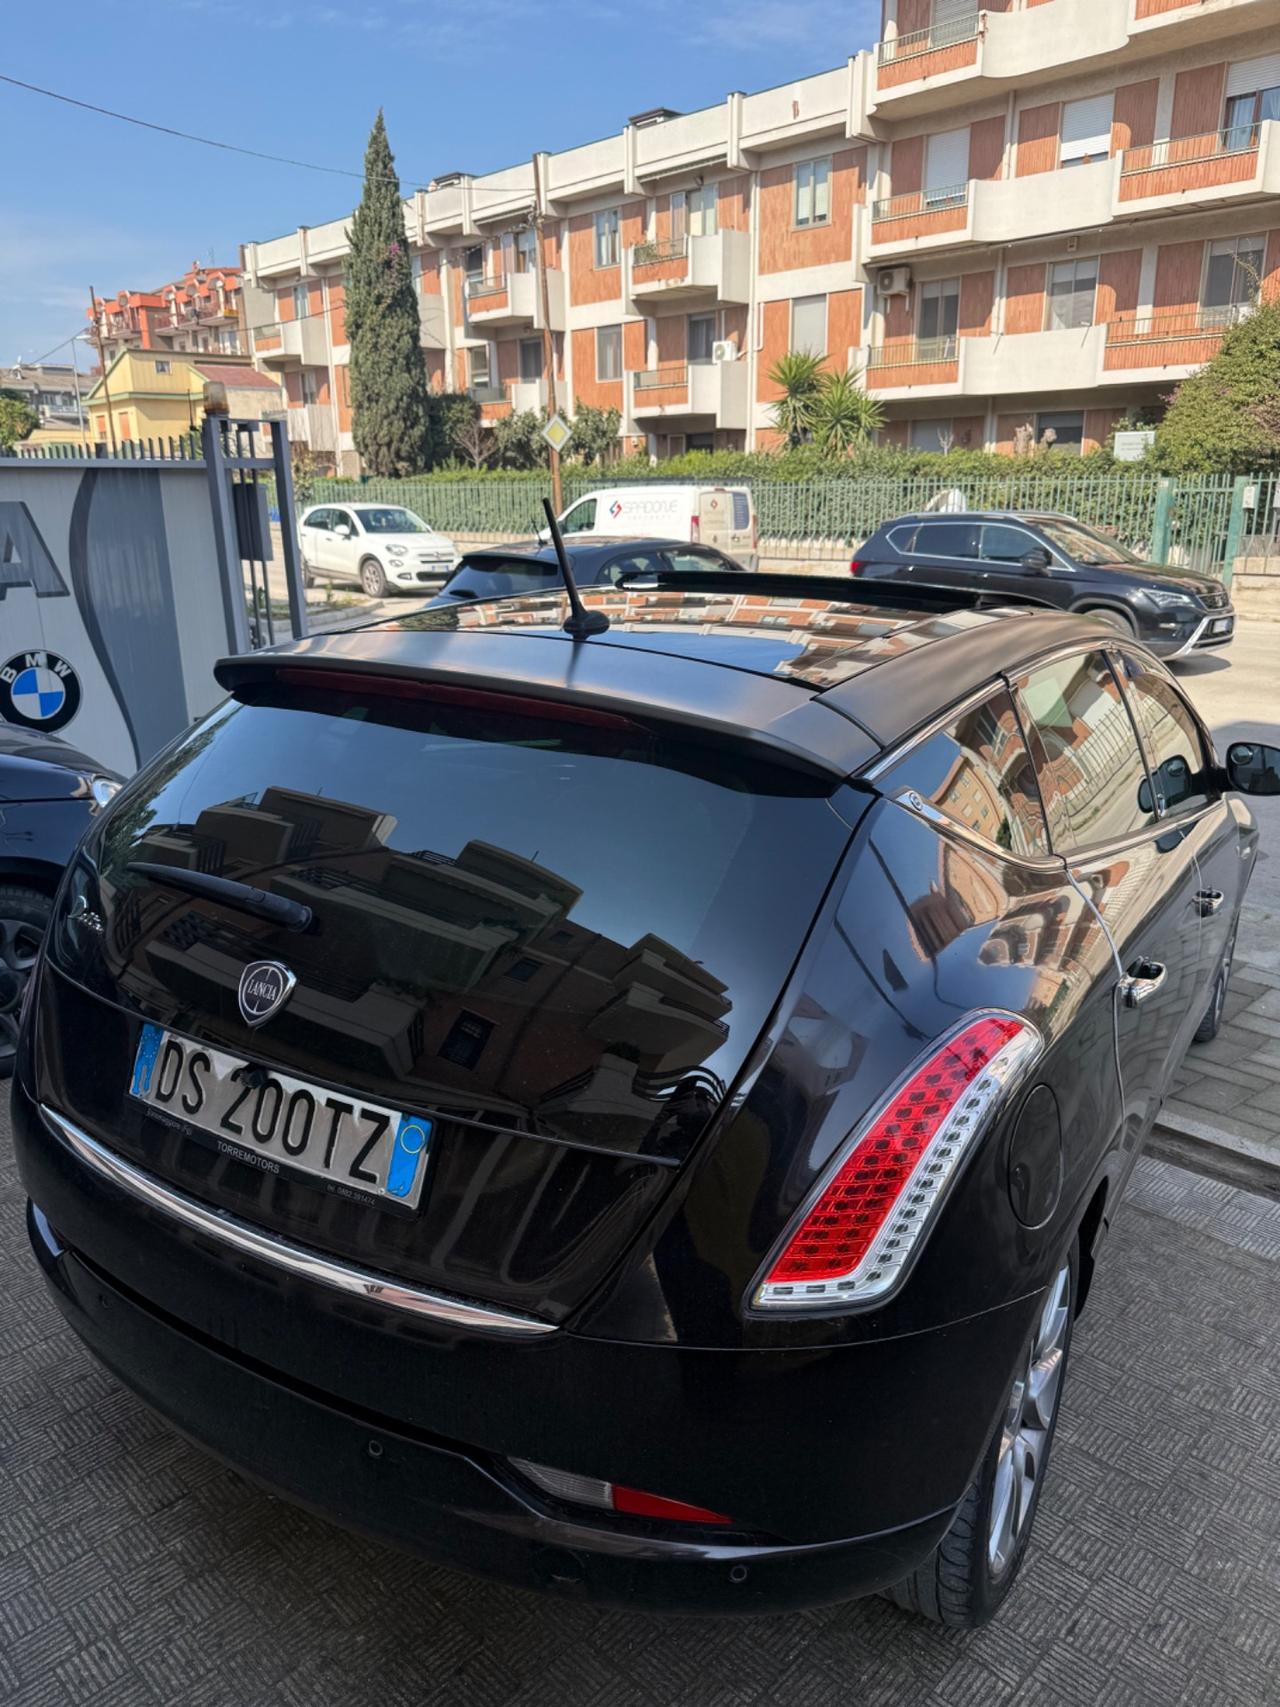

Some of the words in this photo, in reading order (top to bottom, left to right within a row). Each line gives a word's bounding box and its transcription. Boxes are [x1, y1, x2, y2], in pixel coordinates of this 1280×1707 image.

[0, 654, 71, 683] BMW
[247, 979, 277, 1001] LANCIA
[155, 1038, 211, 1115] DS
[220, 1067, 391, 1185] 200TZ
[216, 1140, 280, 1174] TORREMOTORS
